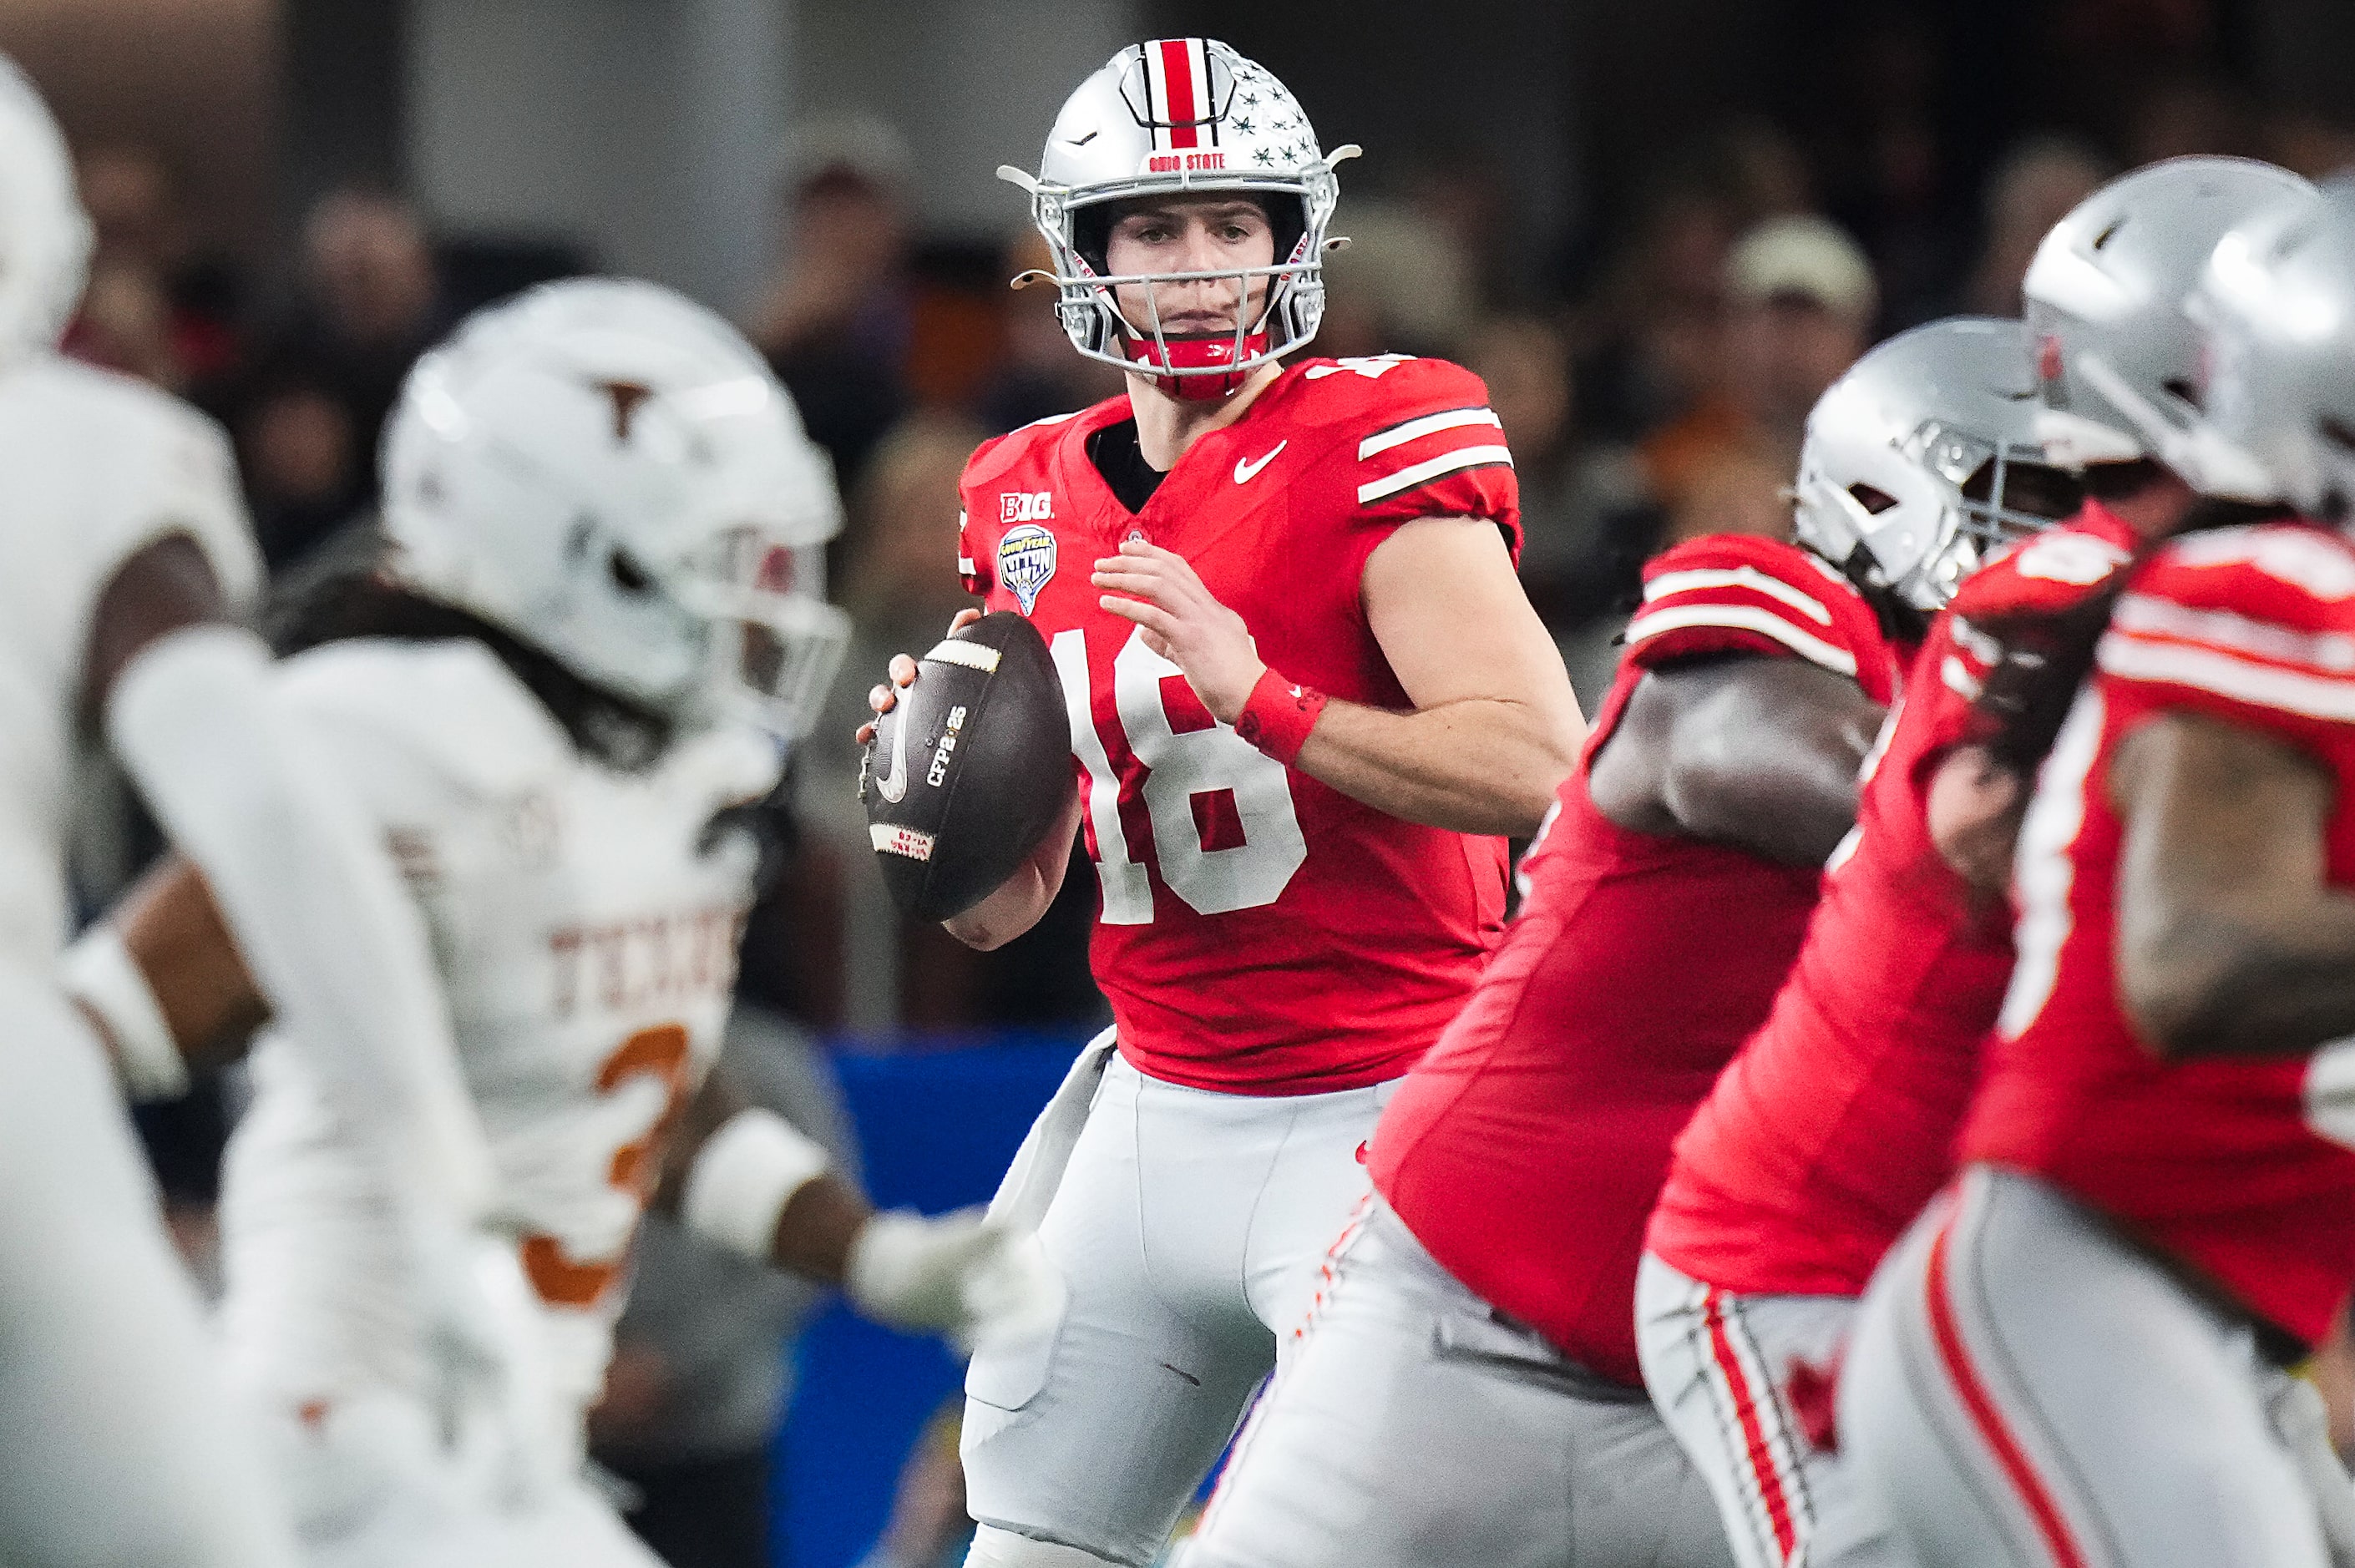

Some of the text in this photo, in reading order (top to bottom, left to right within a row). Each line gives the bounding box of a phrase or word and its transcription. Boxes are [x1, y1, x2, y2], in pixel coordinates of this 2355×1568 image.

[1149, 153, 1226, 173] OHIO STATE
[926, 706, 967, 787] CFP2025
[1050, 623, 1309, 926] 18
[522, 1022, 690, 1311] 3
